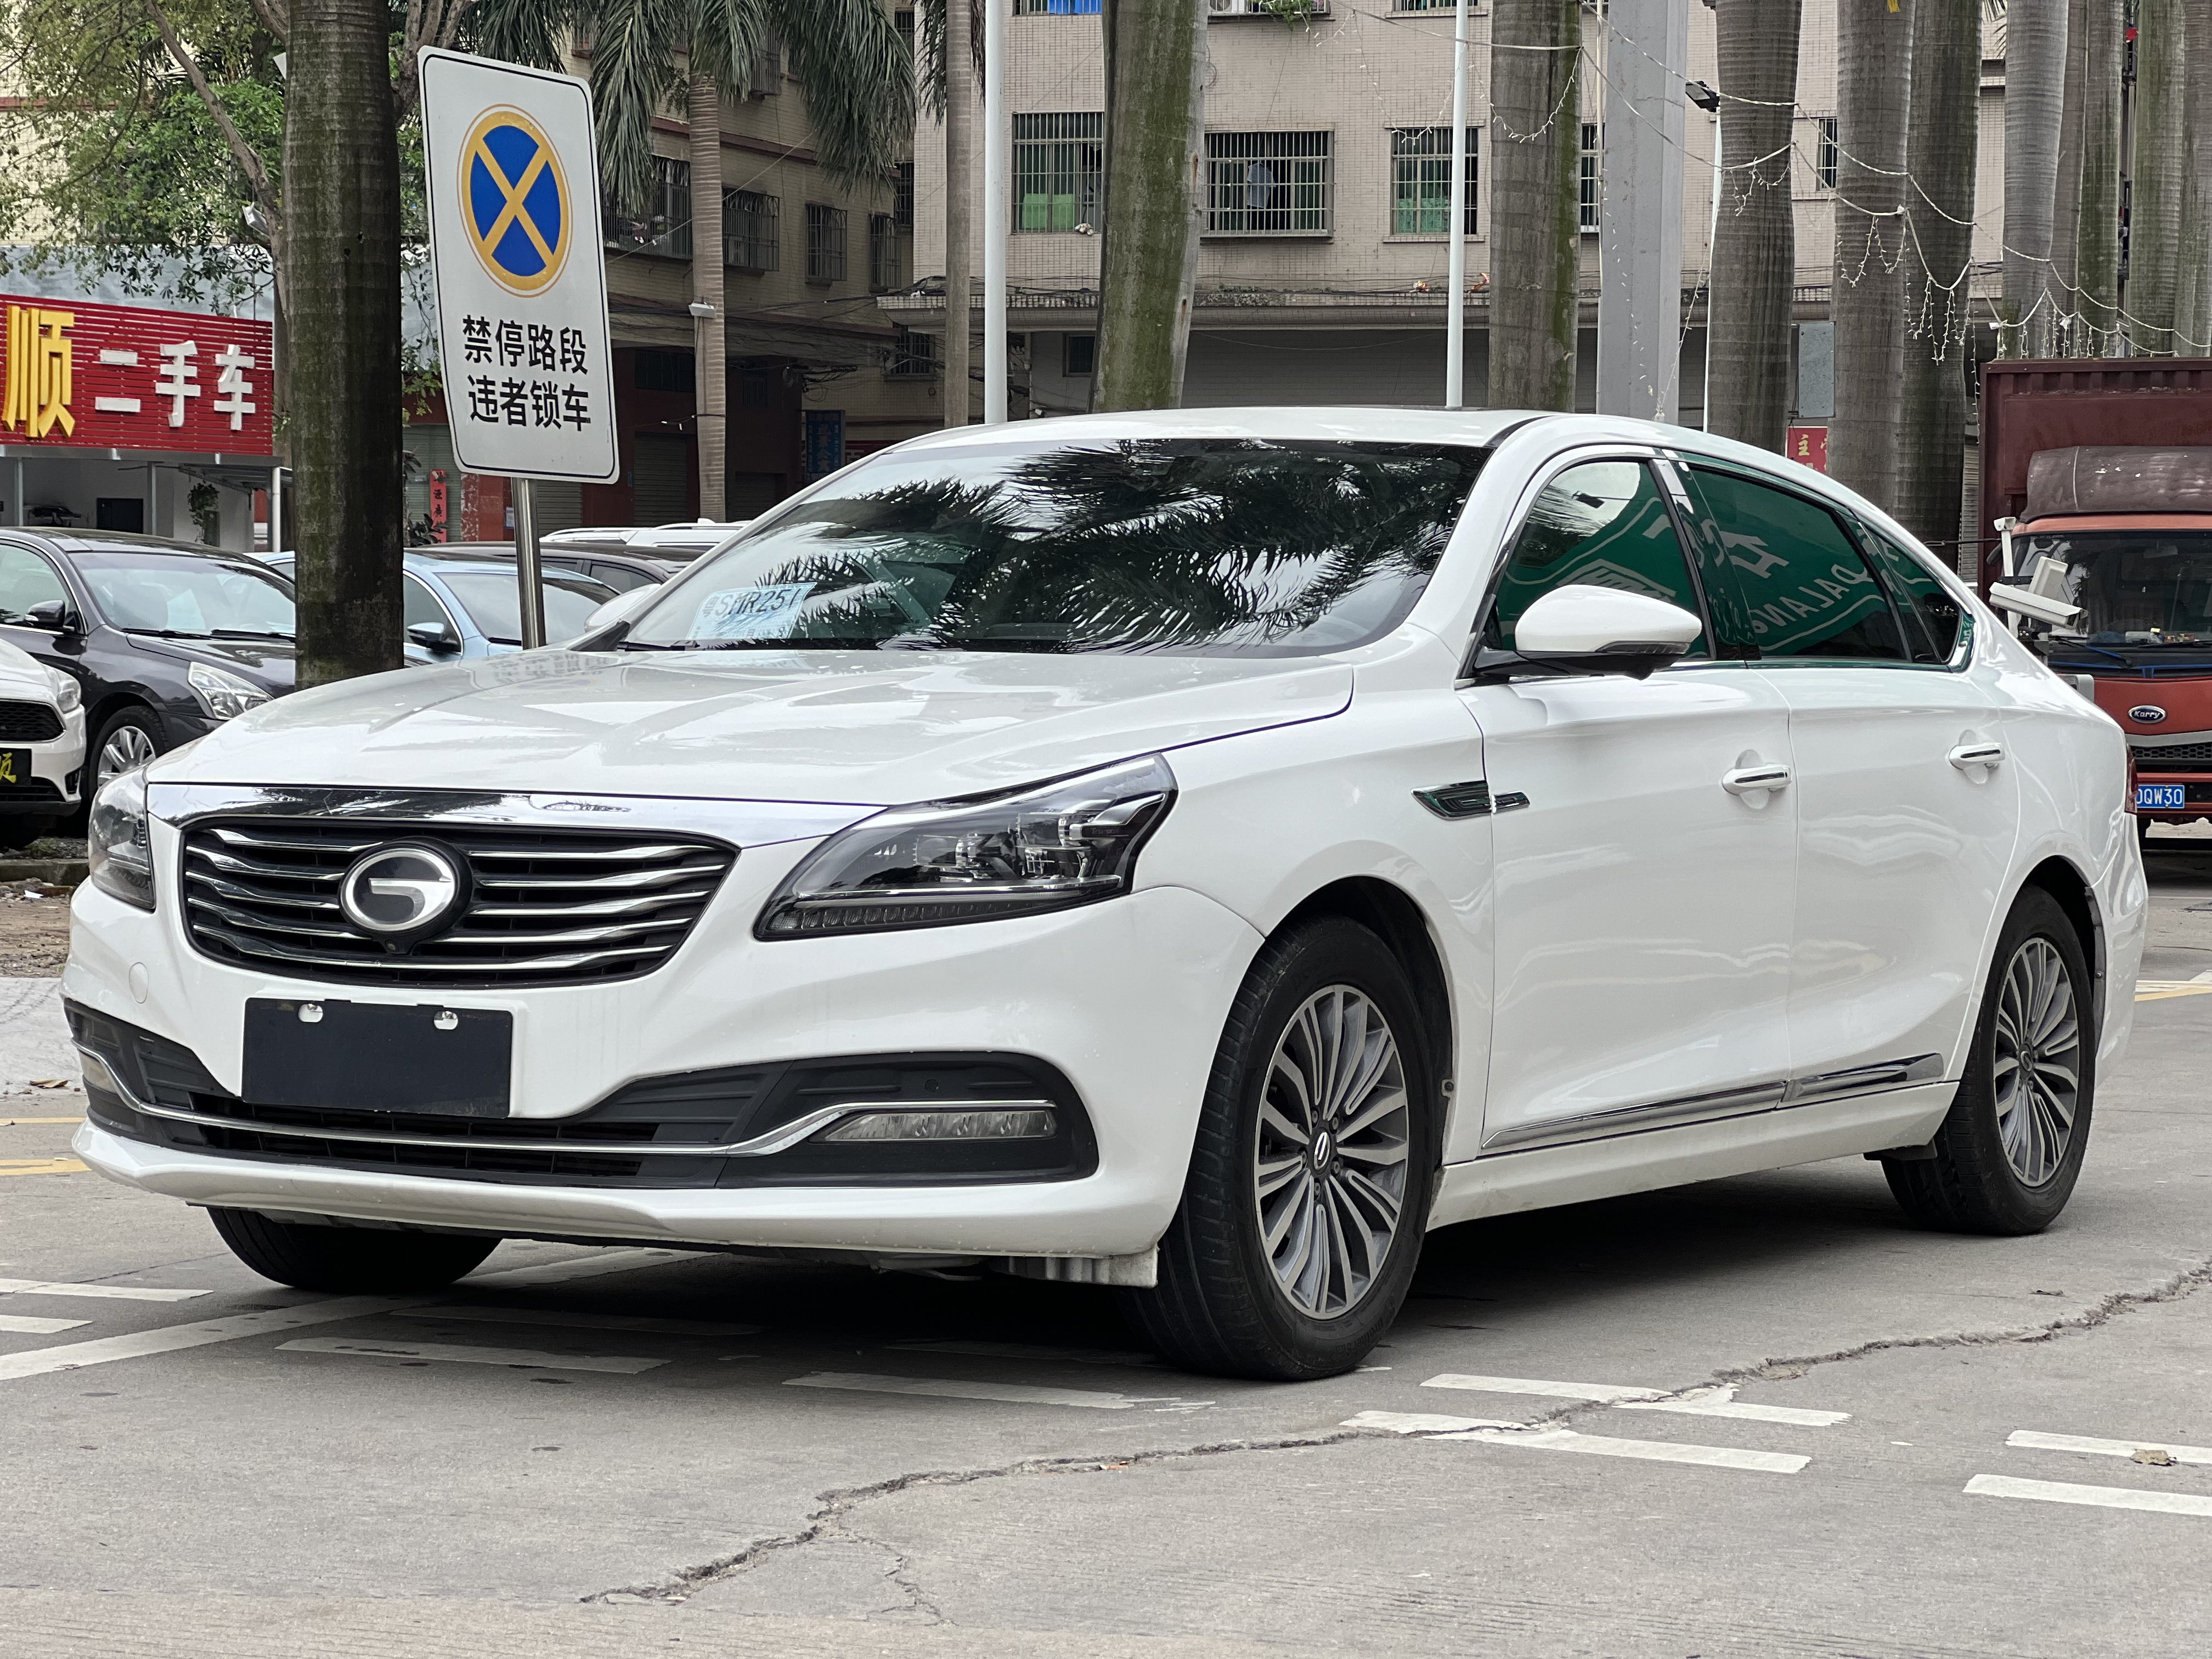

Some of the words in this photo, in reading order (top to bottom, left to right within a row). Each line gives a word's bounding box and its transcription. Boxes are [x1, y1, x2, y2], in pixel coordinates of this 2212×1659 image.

[462, 314, 589, 375] 禁停路段
[467, 375, 591, 432] 违者锁车
[2134, 710, 2161, 719] Karry
